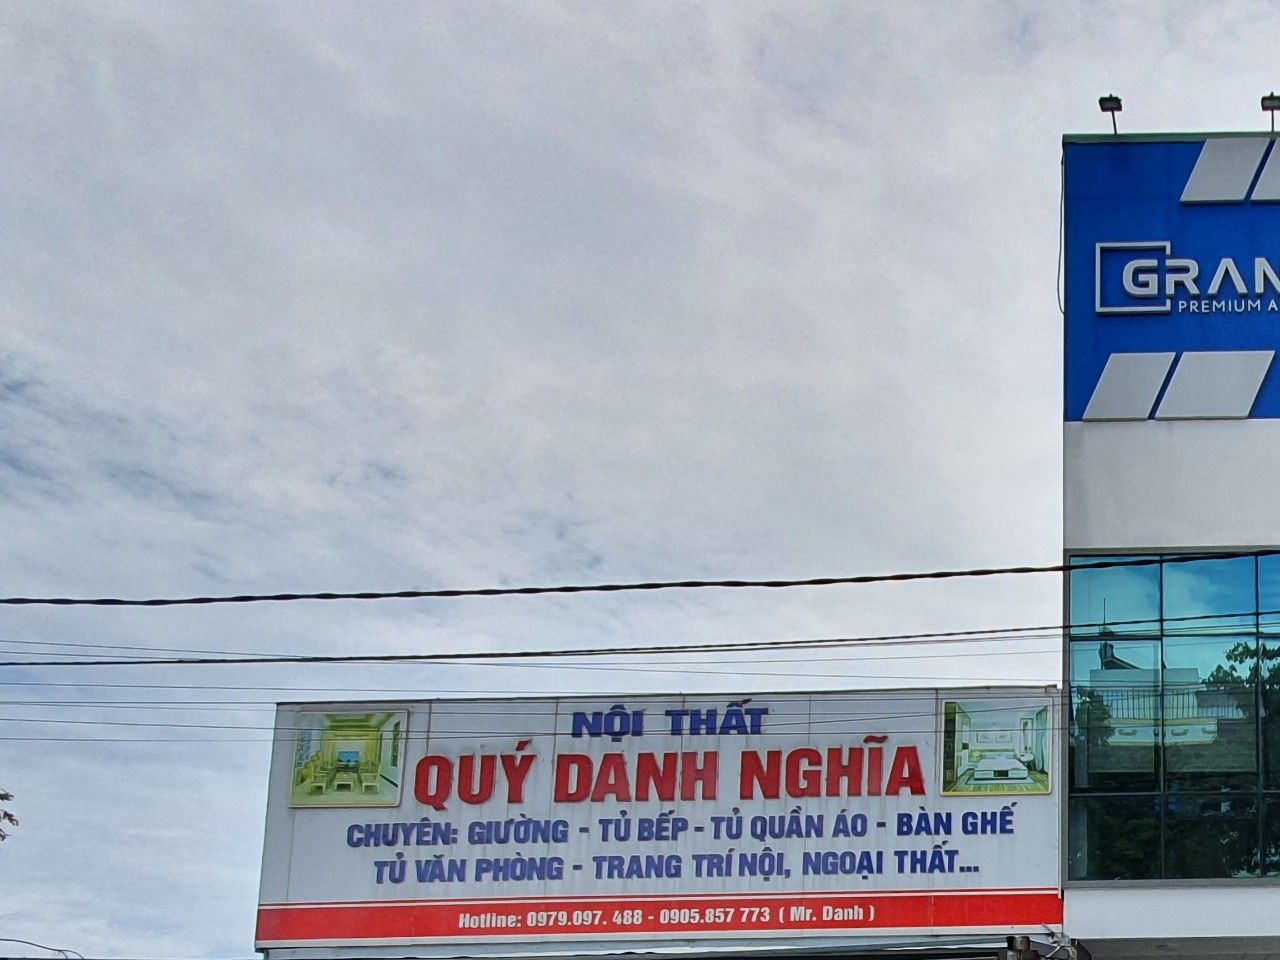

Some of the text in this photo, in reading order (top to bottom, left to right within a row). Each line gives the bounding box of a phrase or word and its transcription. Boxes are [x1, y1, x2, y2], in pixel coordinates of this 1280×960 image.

[1178, 299, 1261, 313] PREMIUM
[571, 698, 770, 742] NỘI THẤT
[413, 735, 926, 811] QUÝ DANH NGHĨA
[346, 817, 459, 848] CHUYÊN:
[467, 813, 569, 845] GIƯỜNG
[598, 809, 632, 842] TỦ
[637, 809, 689, 842] BẾP
[710, 806, 744, 840] TỦ
[751, 805, 824, 840] QUẦN
[832, 808, 868, 838] ÁO
[897, 805, 952, 836] BÀN
[961, 801, 1018, 835] GHẾ
[373, 852, 407, 884] TỦ
[415, 854, 467, 883] VĂN
[474, 852, 564, 881] PHÒNG
[592, 853, 682, 880] TRANG
[692, 848, 733, 877] TRÍ
[738, 846, 791, 882] NỘI,
[802, 849, 883, 880] NGOẠI
[458, 912, 522, 929] Hotline:
[612, 910, 642, 925] 488
[659, 907, 734, 924] 0905.857
[739, 906, 770, 923] 773
[822, 905, 863, 921] Danh
